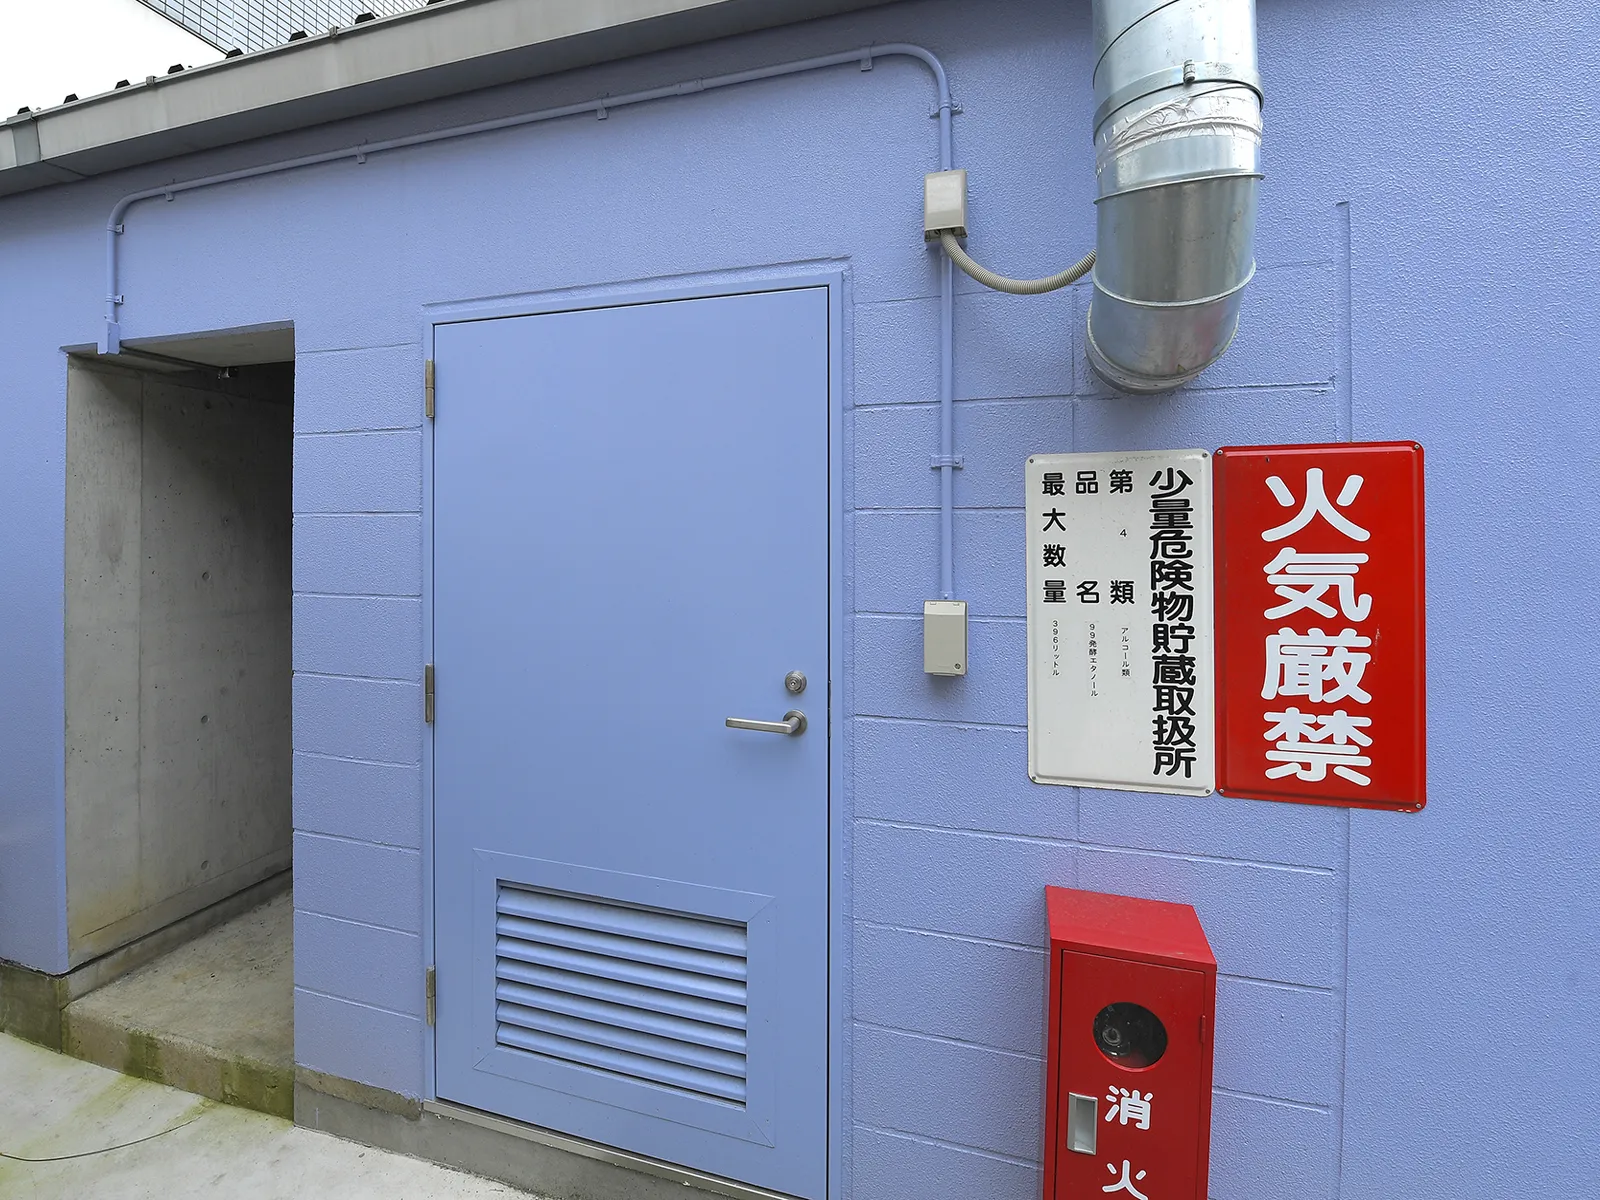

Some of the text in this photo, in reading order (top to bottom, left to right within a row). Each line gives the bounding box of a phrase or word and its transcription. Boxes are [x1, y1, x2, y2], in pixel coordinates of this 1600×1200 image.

[1041, 472, 1067, 676] 最大数量 396リットル
[1121, 627, 1131, 677] アルコール類
[1149, 467, 1197, 779] 少量危険物貯蔵取扱所
[1260, 467, 1372, 787] 火気厳禁
